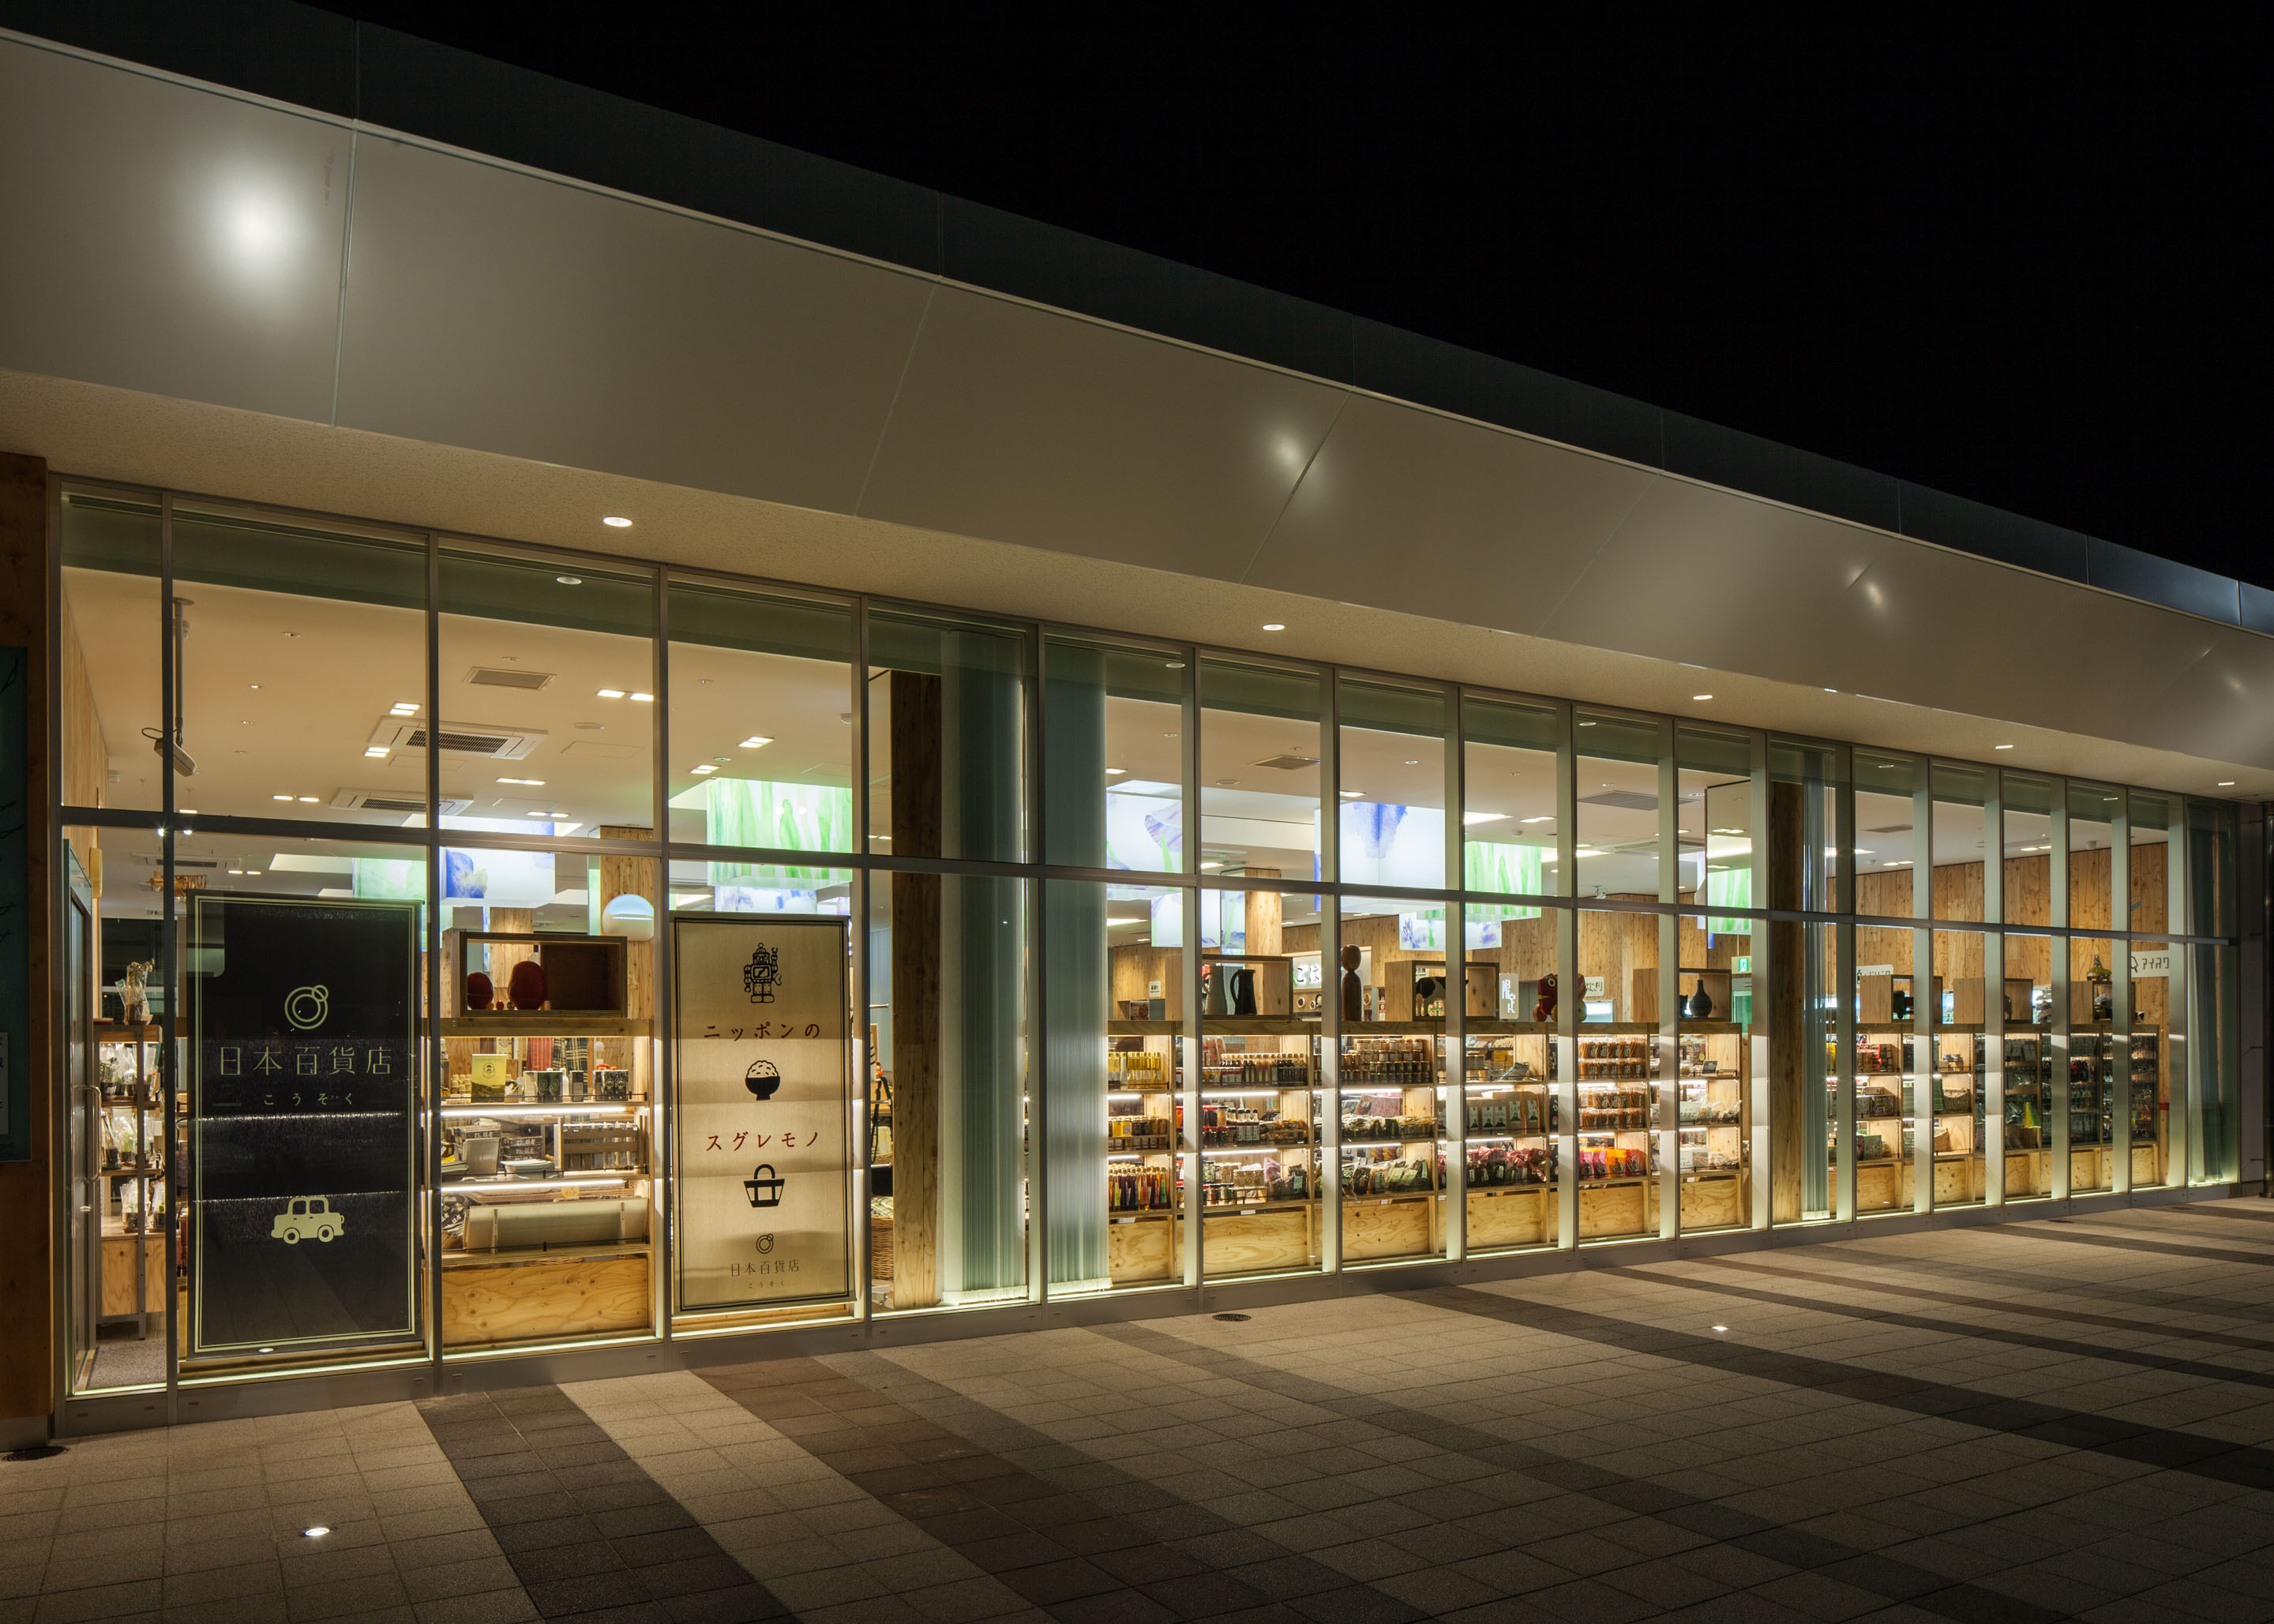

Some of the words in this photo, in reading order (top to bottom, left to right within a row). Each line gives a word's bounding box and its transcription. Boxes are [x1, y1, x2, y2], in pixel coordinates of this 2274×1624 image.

[704, 1021, 820, 1042] ニッポンの
[220, 1046, 392, 1076] 日本百貨店
[264, 1093, 353, 1106] こうそく
[706, 1131, 819, 1152] スグレモノ
[731, 1258, 800, 1277] 日本百貨店
[748, 1280, 785, 1289] こうそく
